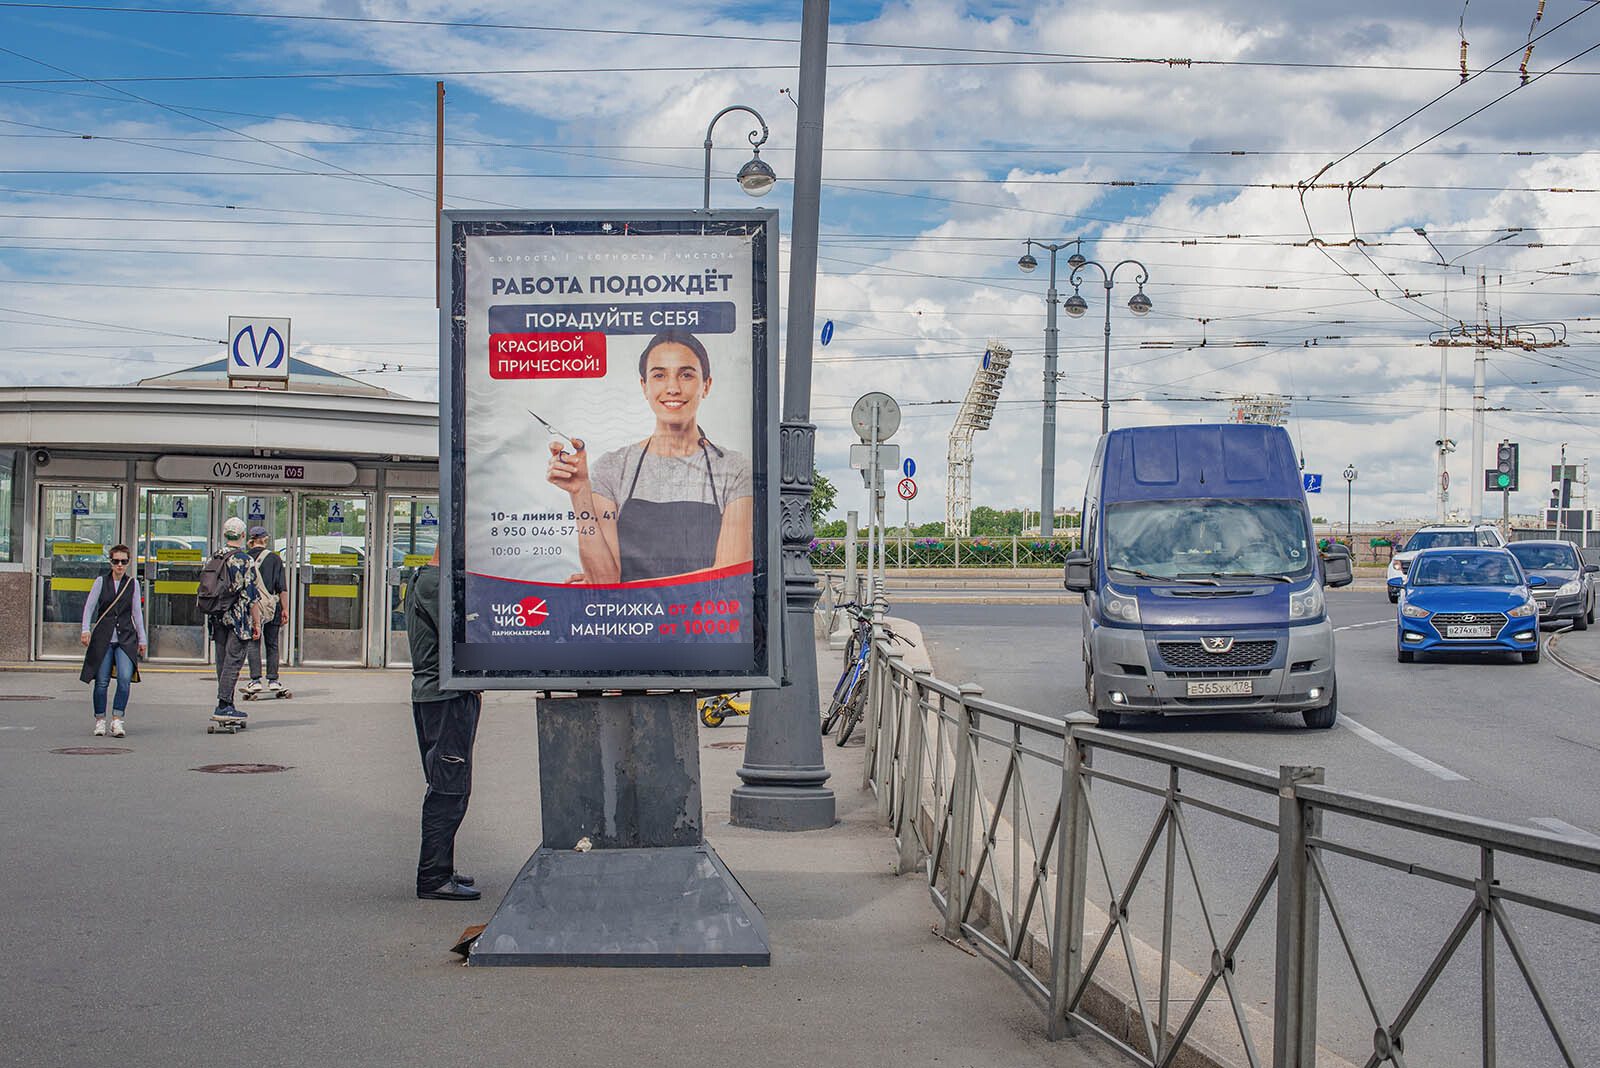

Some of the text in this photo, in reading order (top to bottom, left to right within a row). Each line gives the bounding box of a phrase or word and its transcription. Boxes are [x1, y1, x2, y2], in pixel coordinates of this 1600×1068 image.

[675, 252, 734, 260] ЧИСТОТА
[492, 268, 733, 297] РАБОТА ПОДОЖДЁТ
[525, 307, 700, 330] ПОРАДУЙТЕ СЕБЯ
[497, 335, 584, 353] КРАСИВОЙ
[497, 355, 600, 373] ПРИЧЕСКОЙ!
[232, 462, 283, 471] Спортивная
[235, 471, 279, 480] Sportivnaya
[491, 511, 616, 522] 10-я линия В.О., 41
[491, 526, 596, 536] 8 950 046-57-48
[491, 546, 521, 556] 10:00
[533, 546, 562, 555] 21:00
[491, 603, 523, 615] ЧИО
[585, 603, 665, 617] СТРИЖКА
[668, 604, 687, 616] от
[494, 616, 527, 627] ЧИО
[571, 622, 654, 636] МАНИКЮР
[659, 623, 679, 636] от
